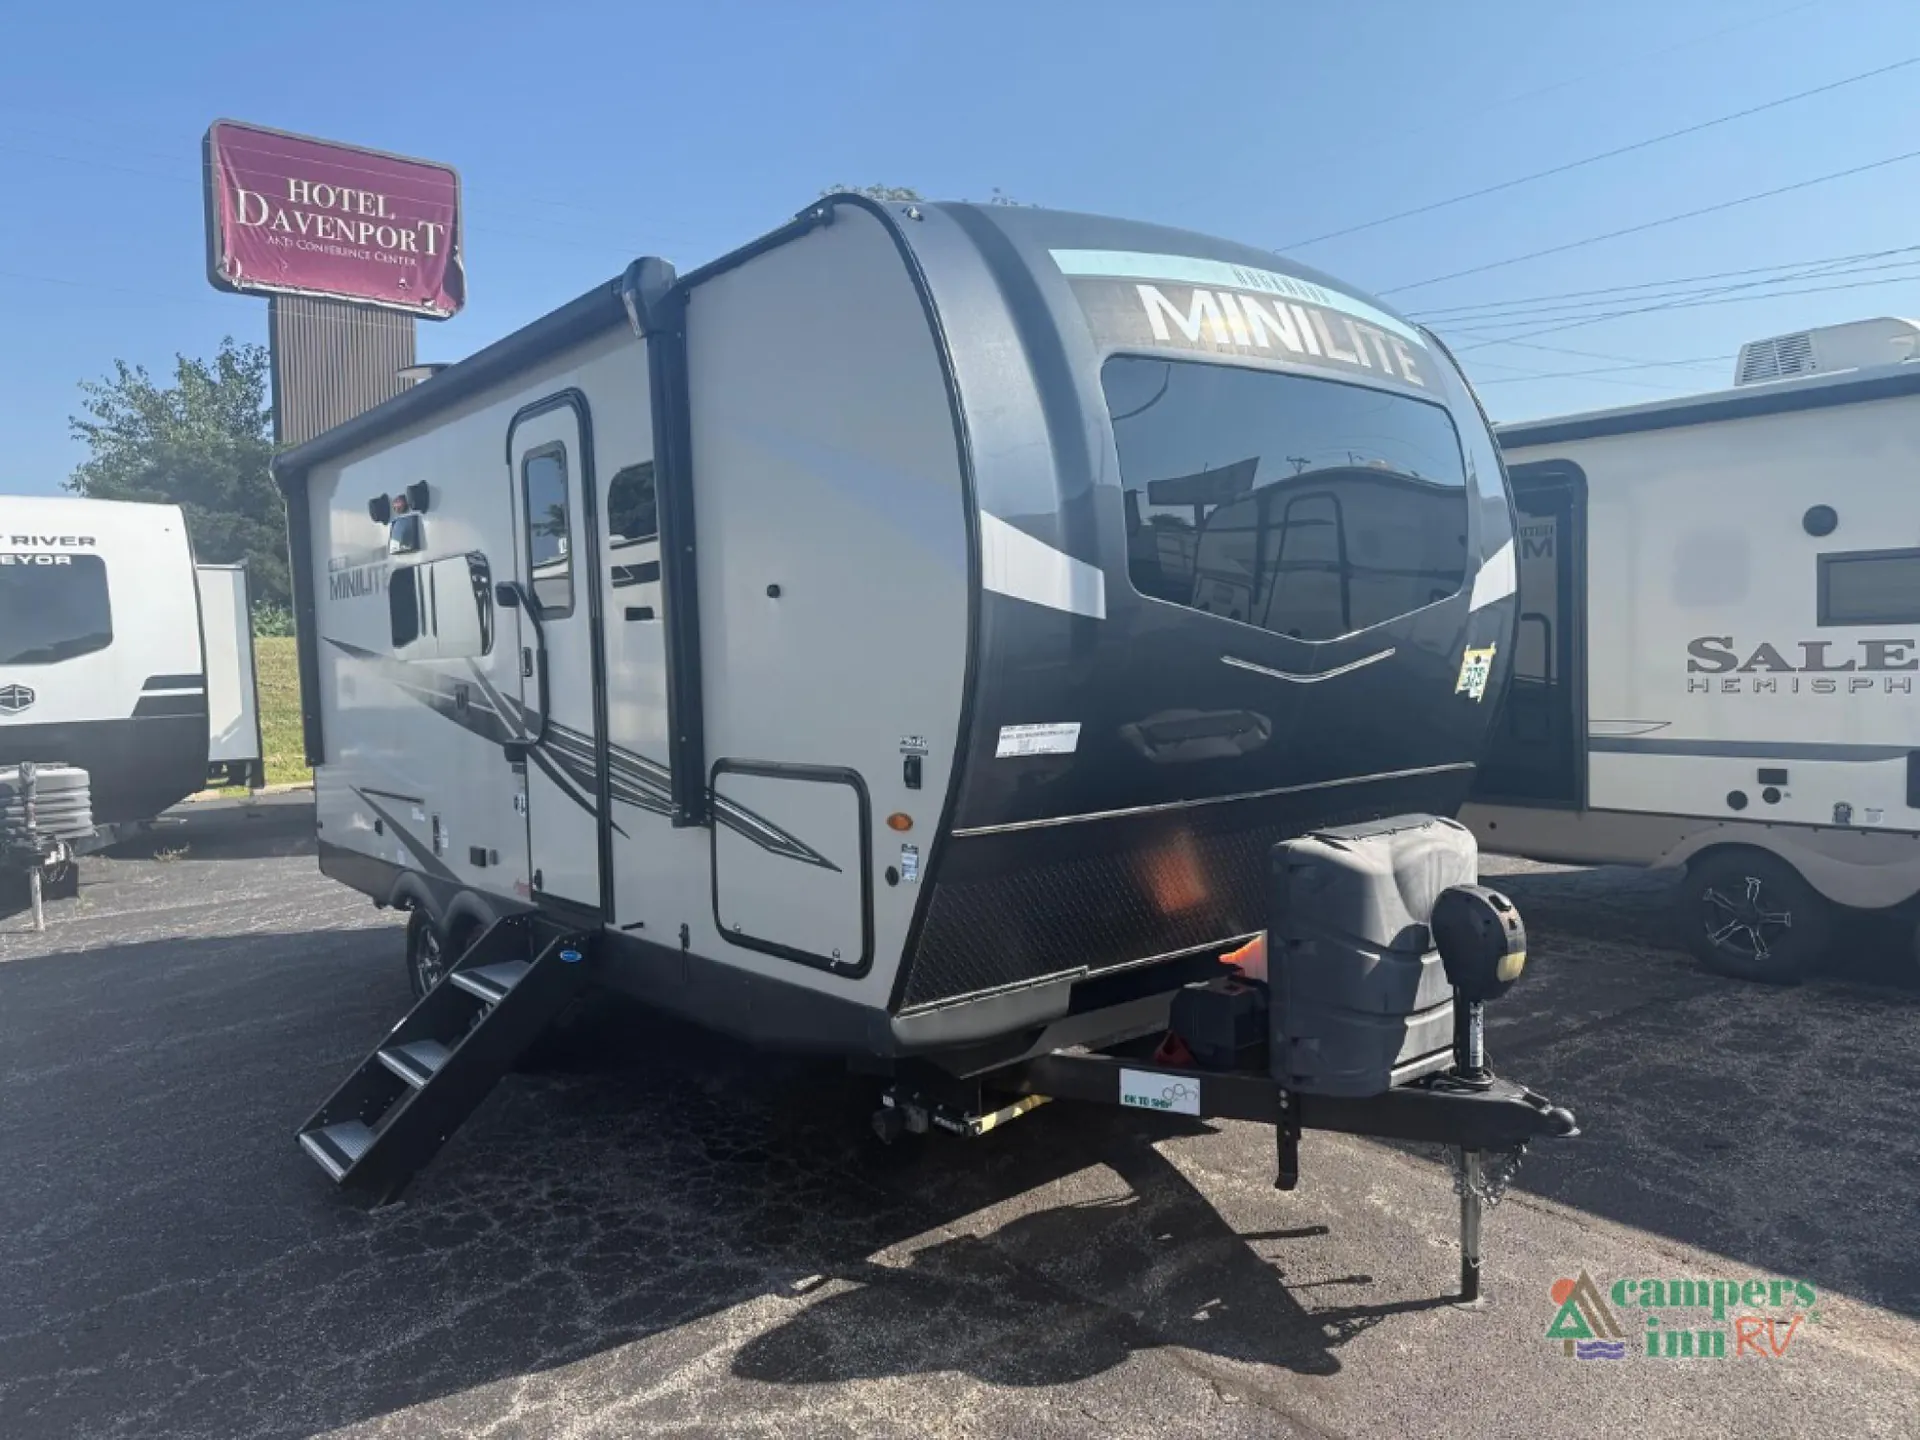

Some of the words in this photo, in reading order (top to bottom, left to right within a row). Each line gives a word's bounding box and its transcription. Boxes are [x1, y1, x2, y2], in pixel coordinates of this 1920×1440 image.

[287, 178, 396, 219] HOTEL
[236, 188, 444, 255] DAVENPORT
[1136, 284, 1425, 386] MINILITE
[11, 535, 96, 546] RIVER
[1687, 636, 1919, 674] SALE
[1687, 677, 1912, 694] HEMISPH
